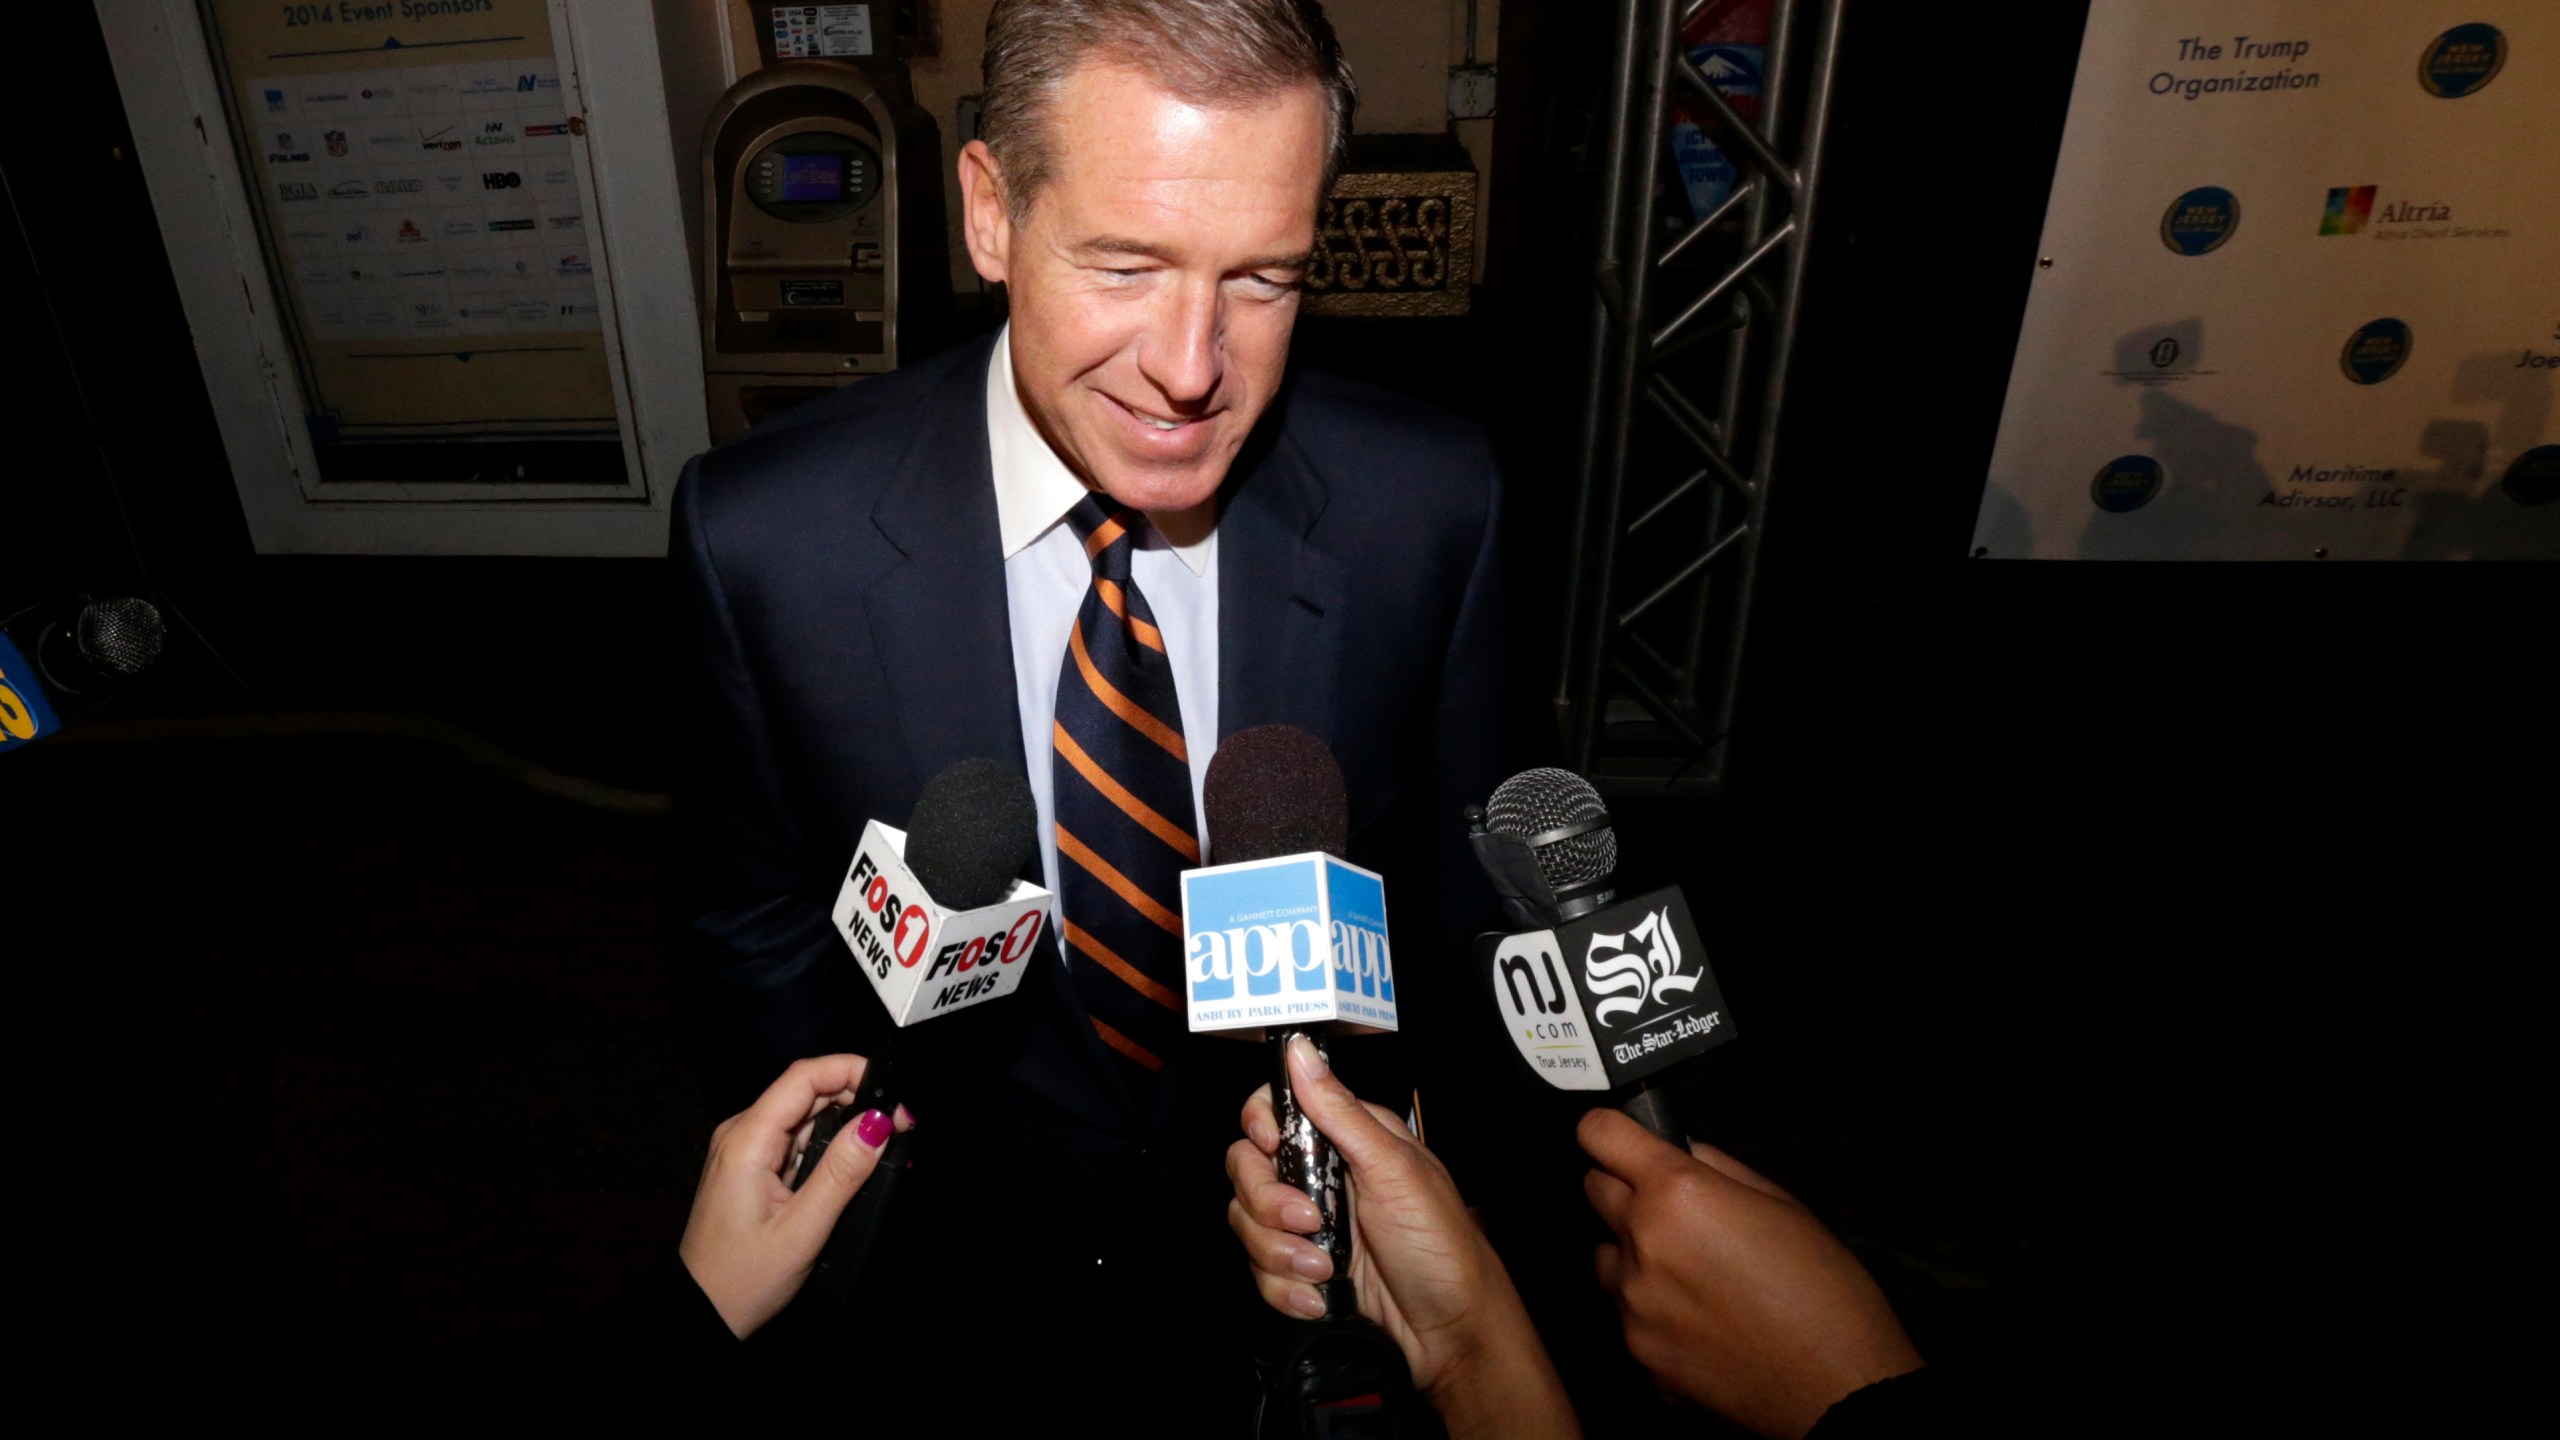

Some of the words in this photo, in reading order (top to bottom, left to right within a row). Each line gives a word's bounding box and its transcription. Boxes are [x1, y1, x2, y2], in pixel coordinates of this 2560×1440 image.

[284, 5, 333, 27] 2014
[340, 1, 394, 22] Event
[402, 0, 492, 21] Sponsors
[2178, 36, 2222, 61] The
[2234, 36, 2309, 63] Trump
[2149, 68, 2320, 101] Organization
[423, 140, 461, 151] verizon
[475, 134, 516, 146] Actavis
[270, 153, 310, 163] FILMS
[482, 172, 520, 190] HBO
[1688, 167, 1730, 182] TOWN
[2377, 200, 2451, 223] Altria
[2288, 464, 2394, 482] Maritime
[2258, 489, 2355, 510] Adivsor,
[2367, 488, 2406, 508] LLC
[1229, 915, 1235, 924] A
[1236, 909, 1274, 923] GANNETT
[1276, 904, 1318, 919] COMPANY
[849, 910, 892, 980] NEWS
[1190, 919, 1327, 1000] app
[1331, 920, 1392, 1003] app
[1585, 905, 1704, 1028] SL
[932, 971, 1000, 1010] NEWS
[1194, 1006, 1244, 1023] ASBURY
[1248, 1003, 1283, 1019] PARK
[1287, 1000, 1329, 1015] PRESS
[1338, 1001, 1361, 1015] ASBURY
[1362, 1005, 1378, 1019] PARK
[1379, 1008, 1396, 1022] PRESS
[1613, 1043, 1643, 1065] The
[1642, 1010, 1721, 1053] Star-Ledger
[1536, 1055, 1559, 1070] True
[1559, 1055, 1590, 1071] Jersey.
